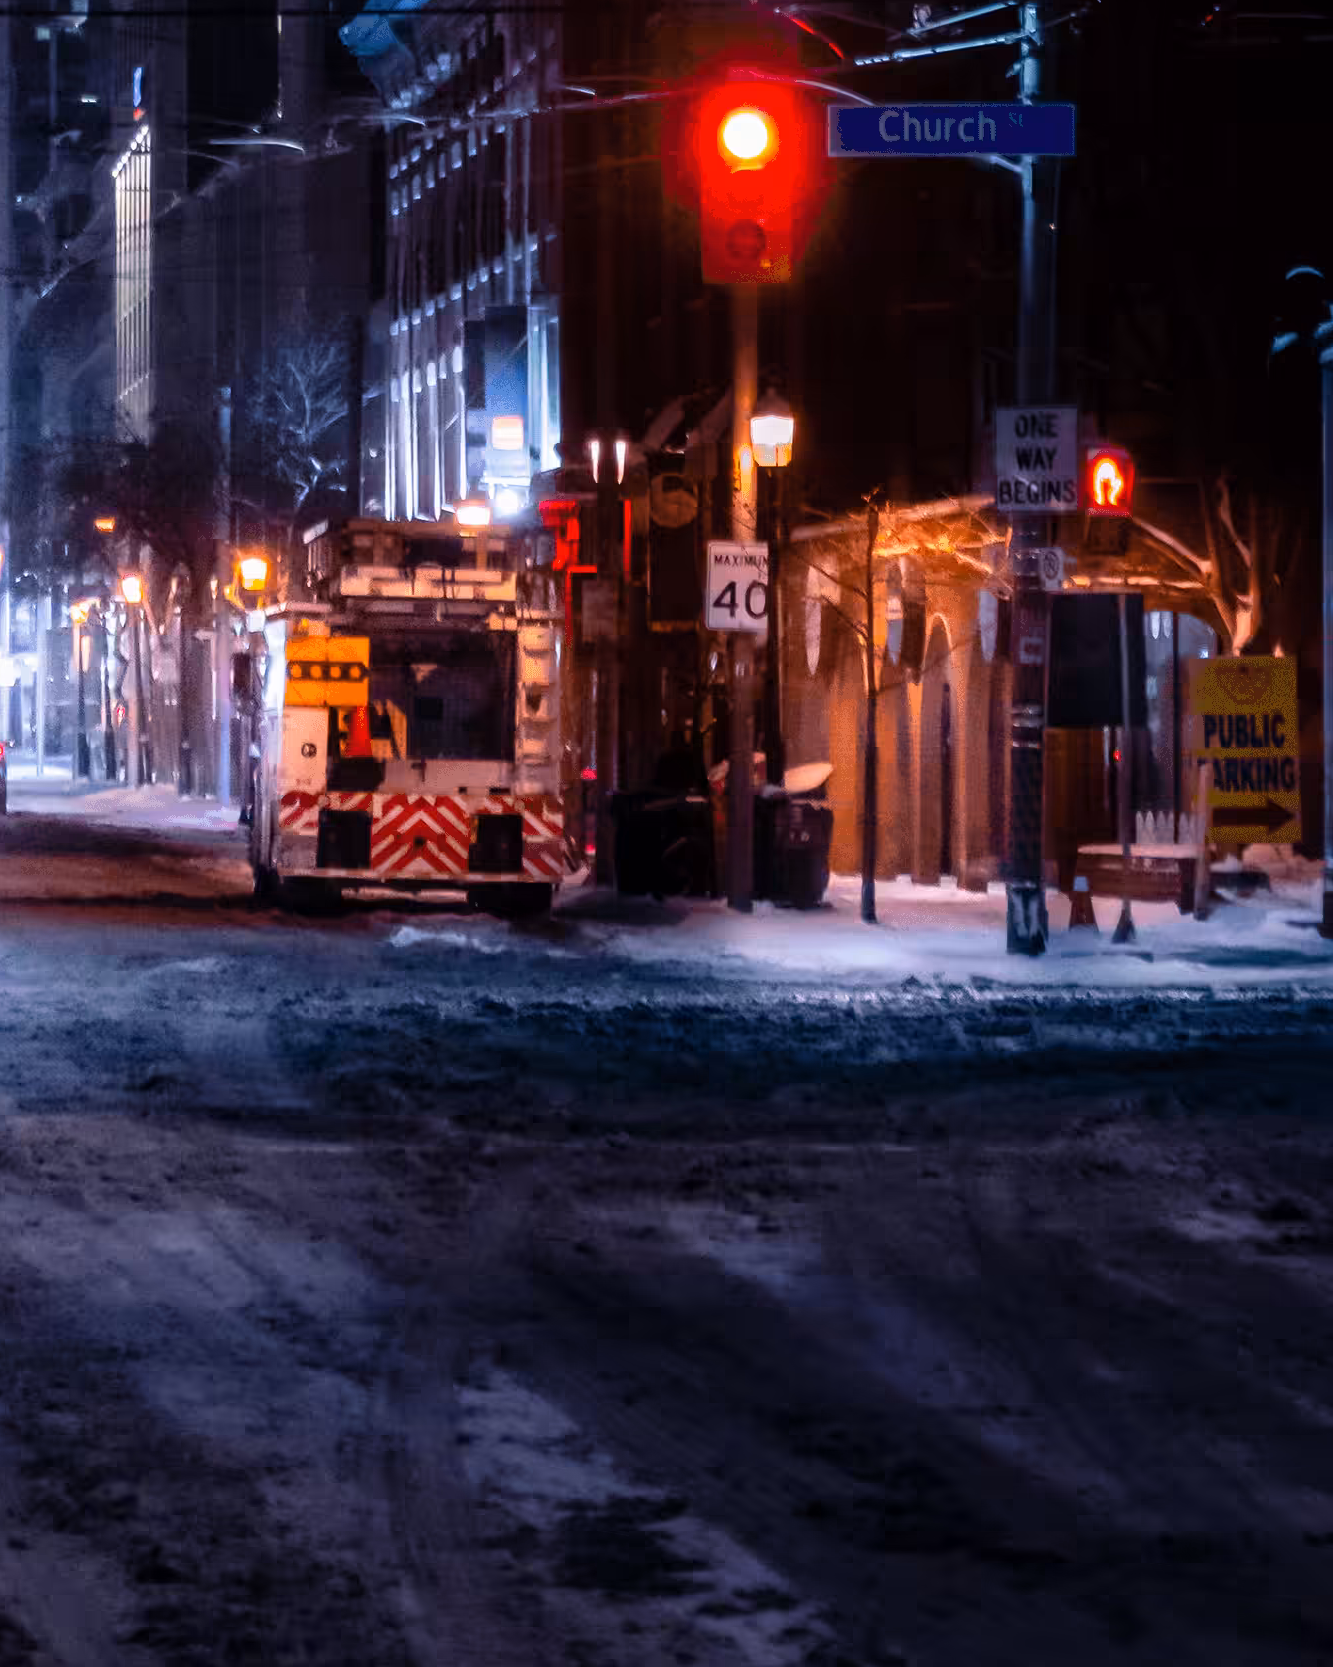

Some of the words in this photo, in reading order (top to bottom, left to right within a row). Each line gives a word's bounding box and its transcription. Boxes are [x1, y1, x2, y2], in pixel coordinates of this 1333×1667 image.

[879, 111, 996, 142] Church
[1015, 414, 1058, 438] ONE
[1016, 448, 1056, 470] WAY
[999, 480, 1075, 504] BEGINS
[713, 580, 768, 619] 40
[1204, 714, 1285, 748] PUBLIC
